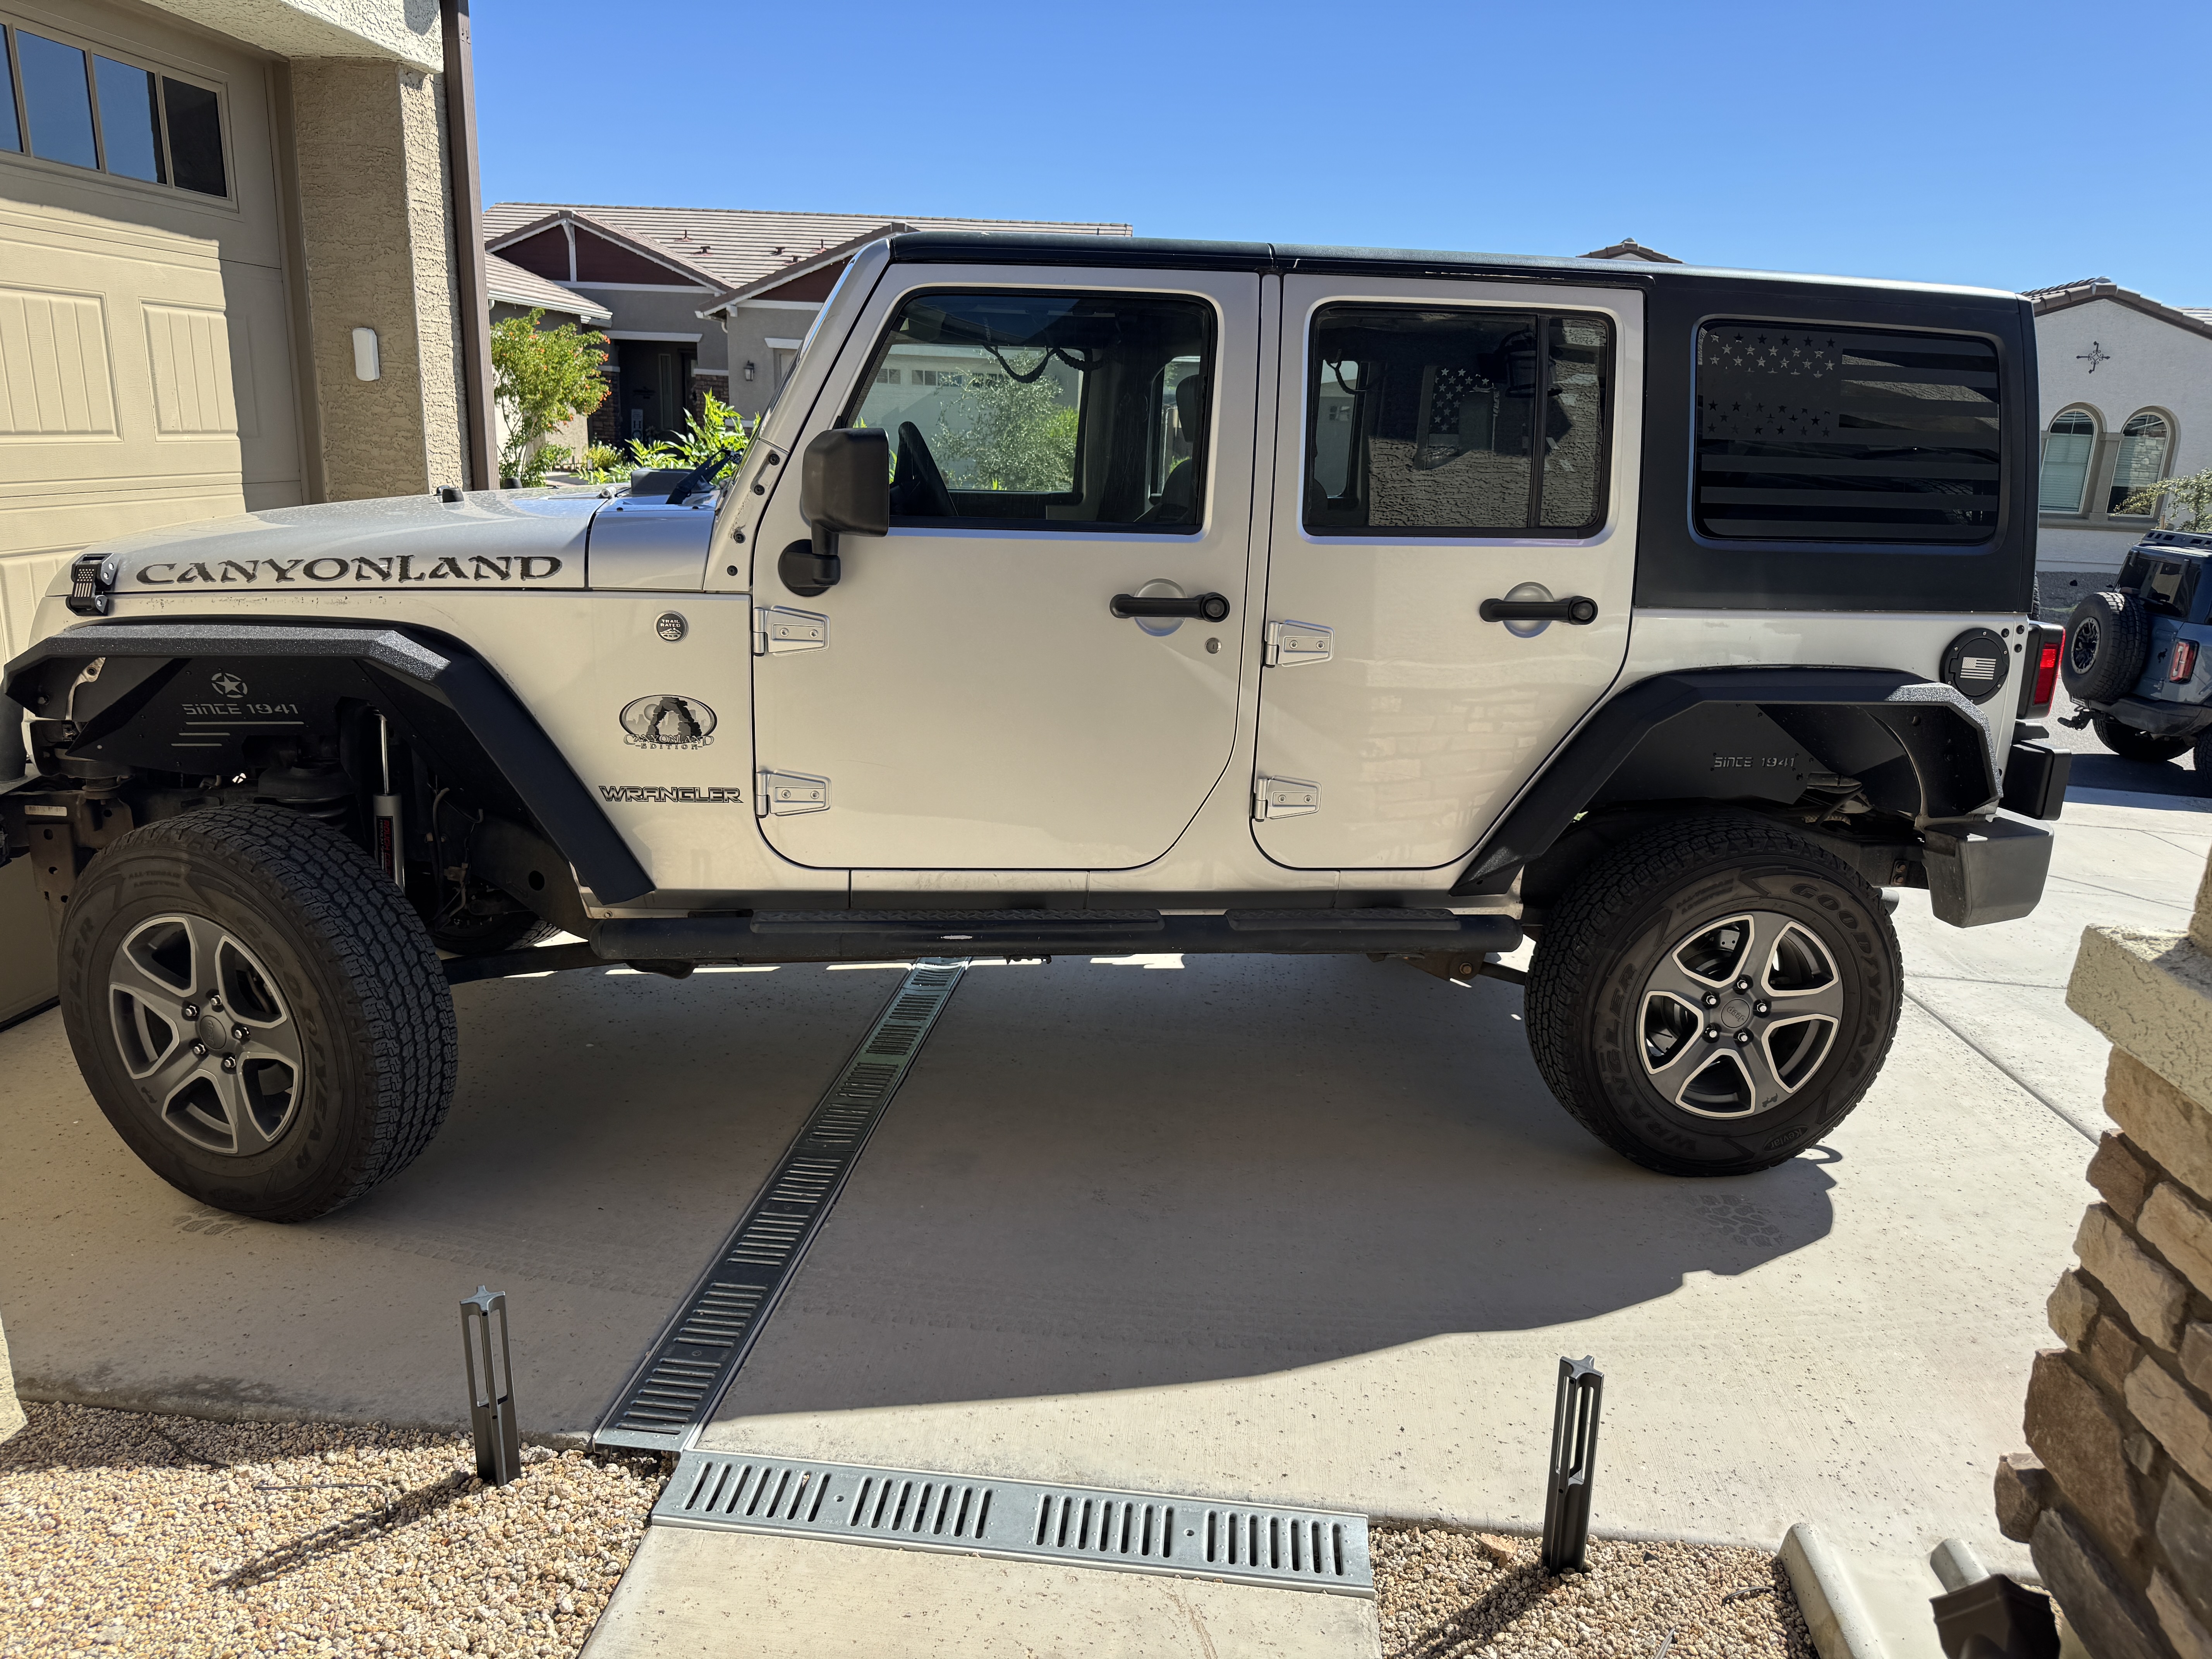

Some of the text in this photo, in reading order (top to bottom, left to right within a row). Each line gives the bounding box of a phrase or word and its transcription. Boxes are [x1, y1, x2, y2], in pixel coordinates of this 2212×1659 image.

[136, 554, 563, 584] CANYONLAND
[246, 704, 299, 714] 1941
[623, 734, 714, 746] CANYONLAND
[1762, 757, 1795, 768] 1941
[598, 785, 744, 803] WRANGLER
[1791, 884, 1881, 1078] GOODYEAR
[1726, 1006, 1746, 1022] Jeep
[207, 1020, 216, 1046] Jeep
[237, 915, 328, 1170] GOODYEAR
[1606, 963, 1697, 1152] WRANGLER
[1770, 1128, 1803, 1149] Kevlar
